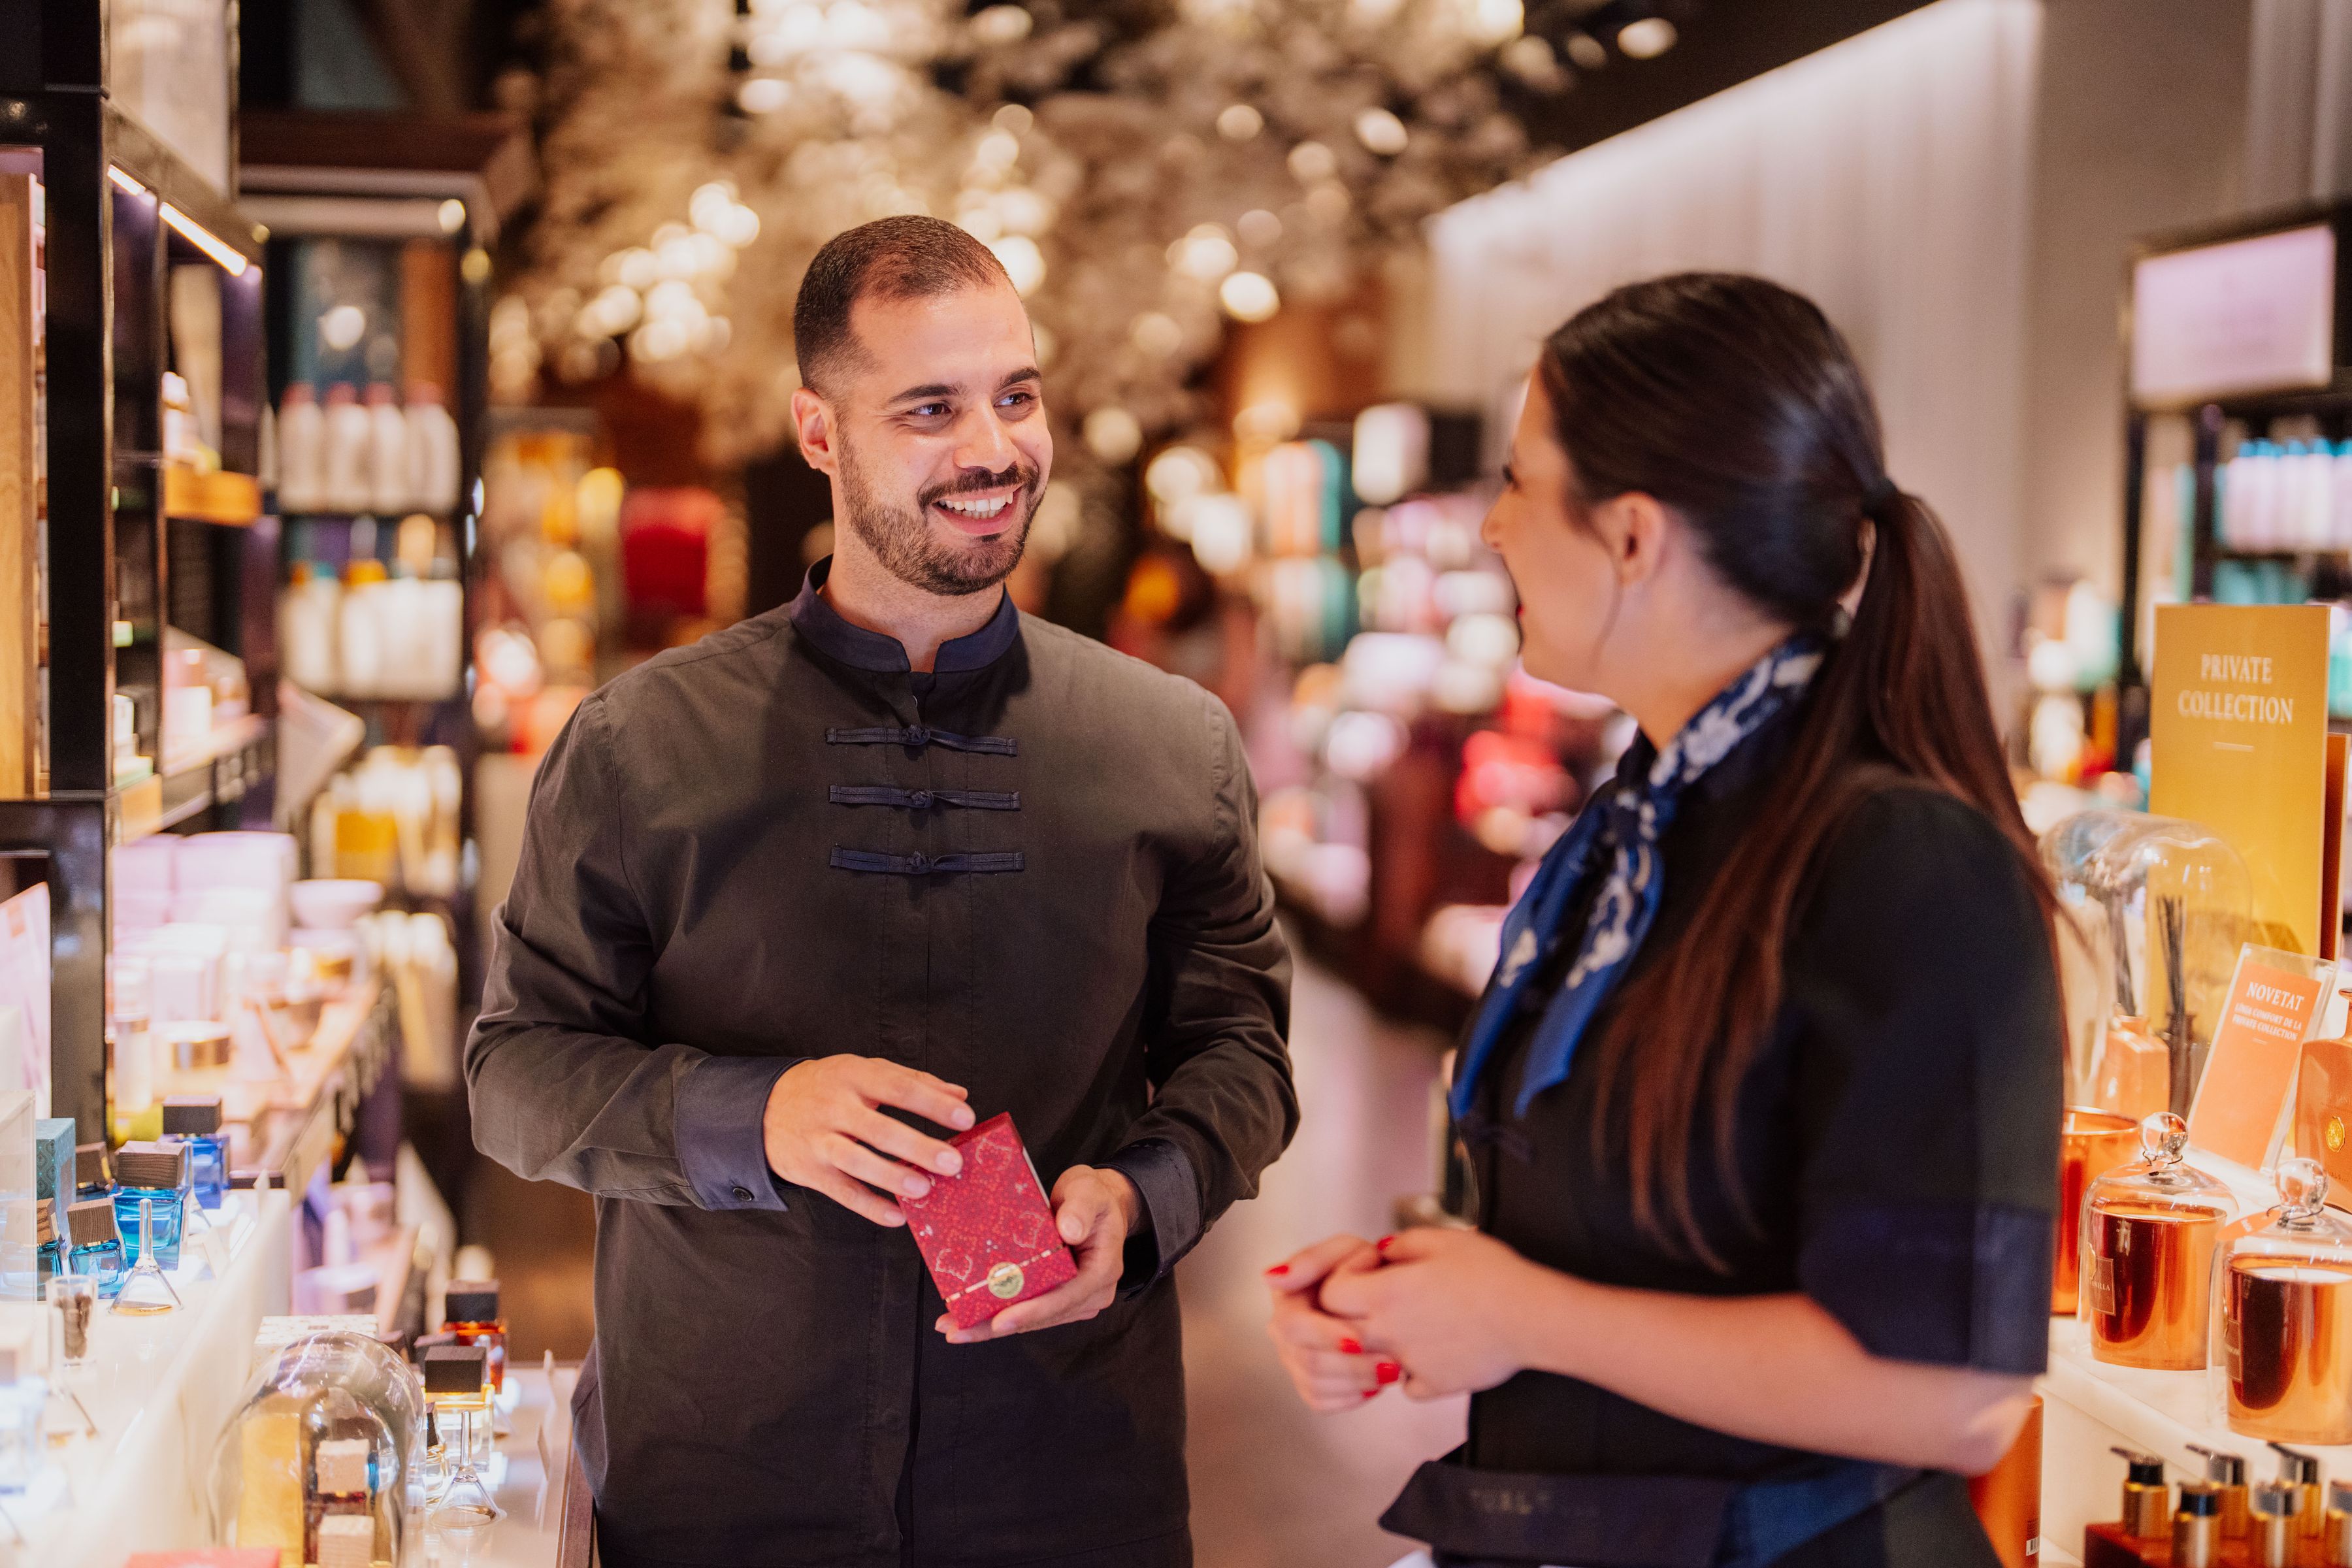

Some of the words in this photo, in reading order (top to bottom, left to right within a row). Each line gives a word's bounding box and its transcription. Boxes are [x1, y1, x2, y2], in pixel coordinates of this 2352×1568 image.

[2200, 653, 2272, 684] PRIVATE
[2178, 689, 2294, 724] COLLECTION
[2246, 981, 2304, 1011] NOVETAT
[2232, 1013, 2257, 1030] PRIVATE
[2257, 1022, 2298, 1041] COLLECTION
[2252, 1008, 2284, 1025] COMFORT
[2283, 1017, 2293, 1028] DE
[2293, 1020, 2302, 1031] LA
